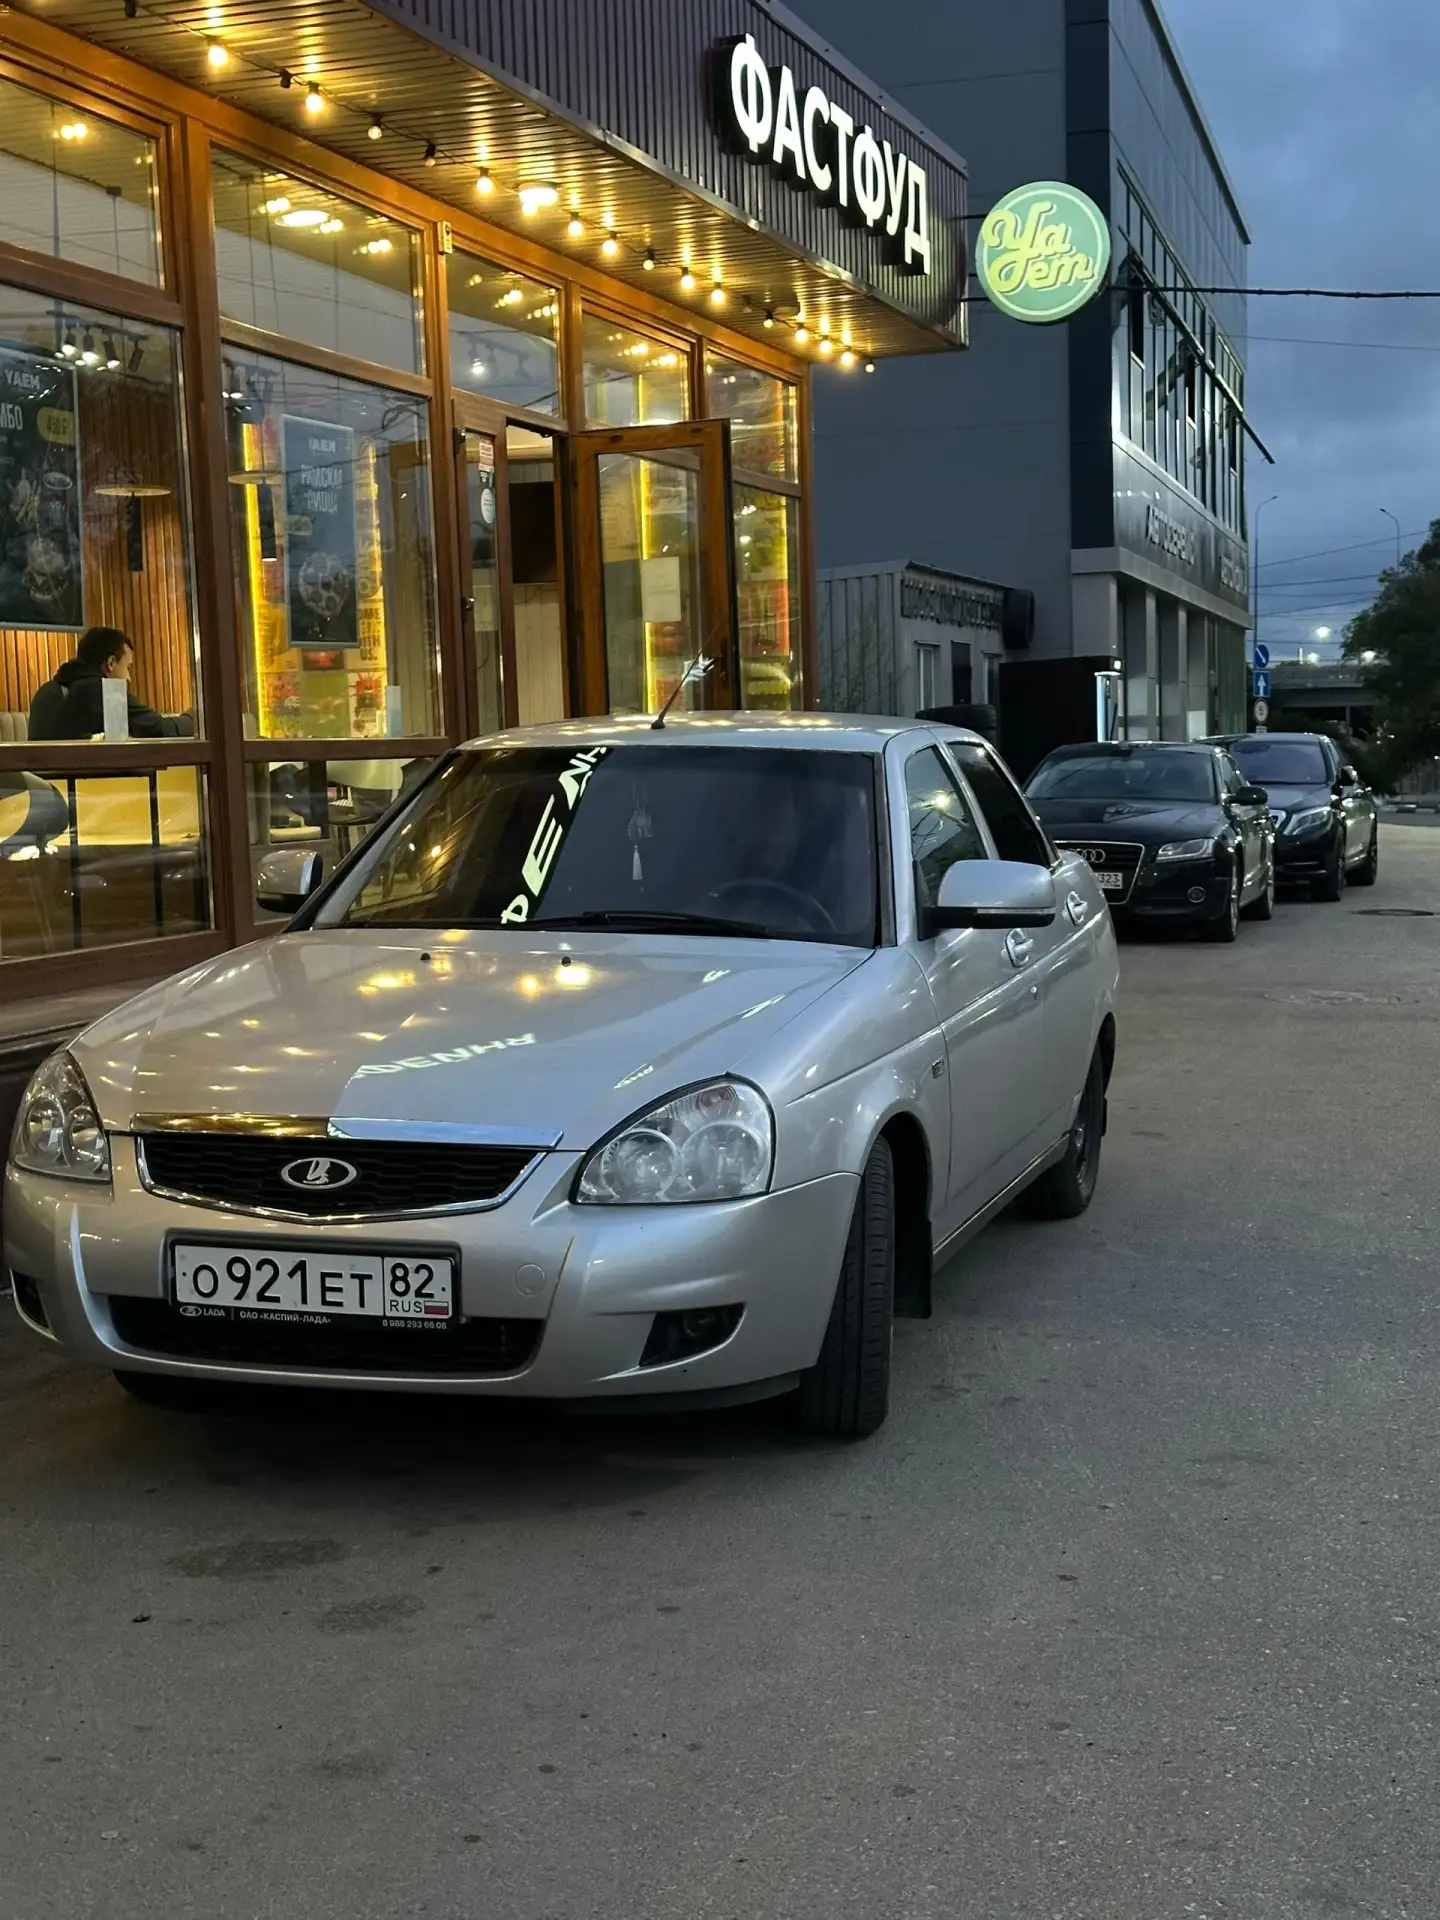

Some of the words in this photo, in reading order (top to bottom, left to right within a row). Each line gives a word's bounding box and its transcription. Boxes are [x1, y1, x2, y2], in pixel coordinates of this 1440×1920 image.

[729, 33, 931, 276] ФАСТФУД
[192, 1255, 374, 1309] О921ЕТ
[389, 1261, 435, 1299] 82
[203, 1307, 226, 1317] LADA
[239, 1310, 258, 1320] ОАО
[389, 1299, 423, 1313] RUS
